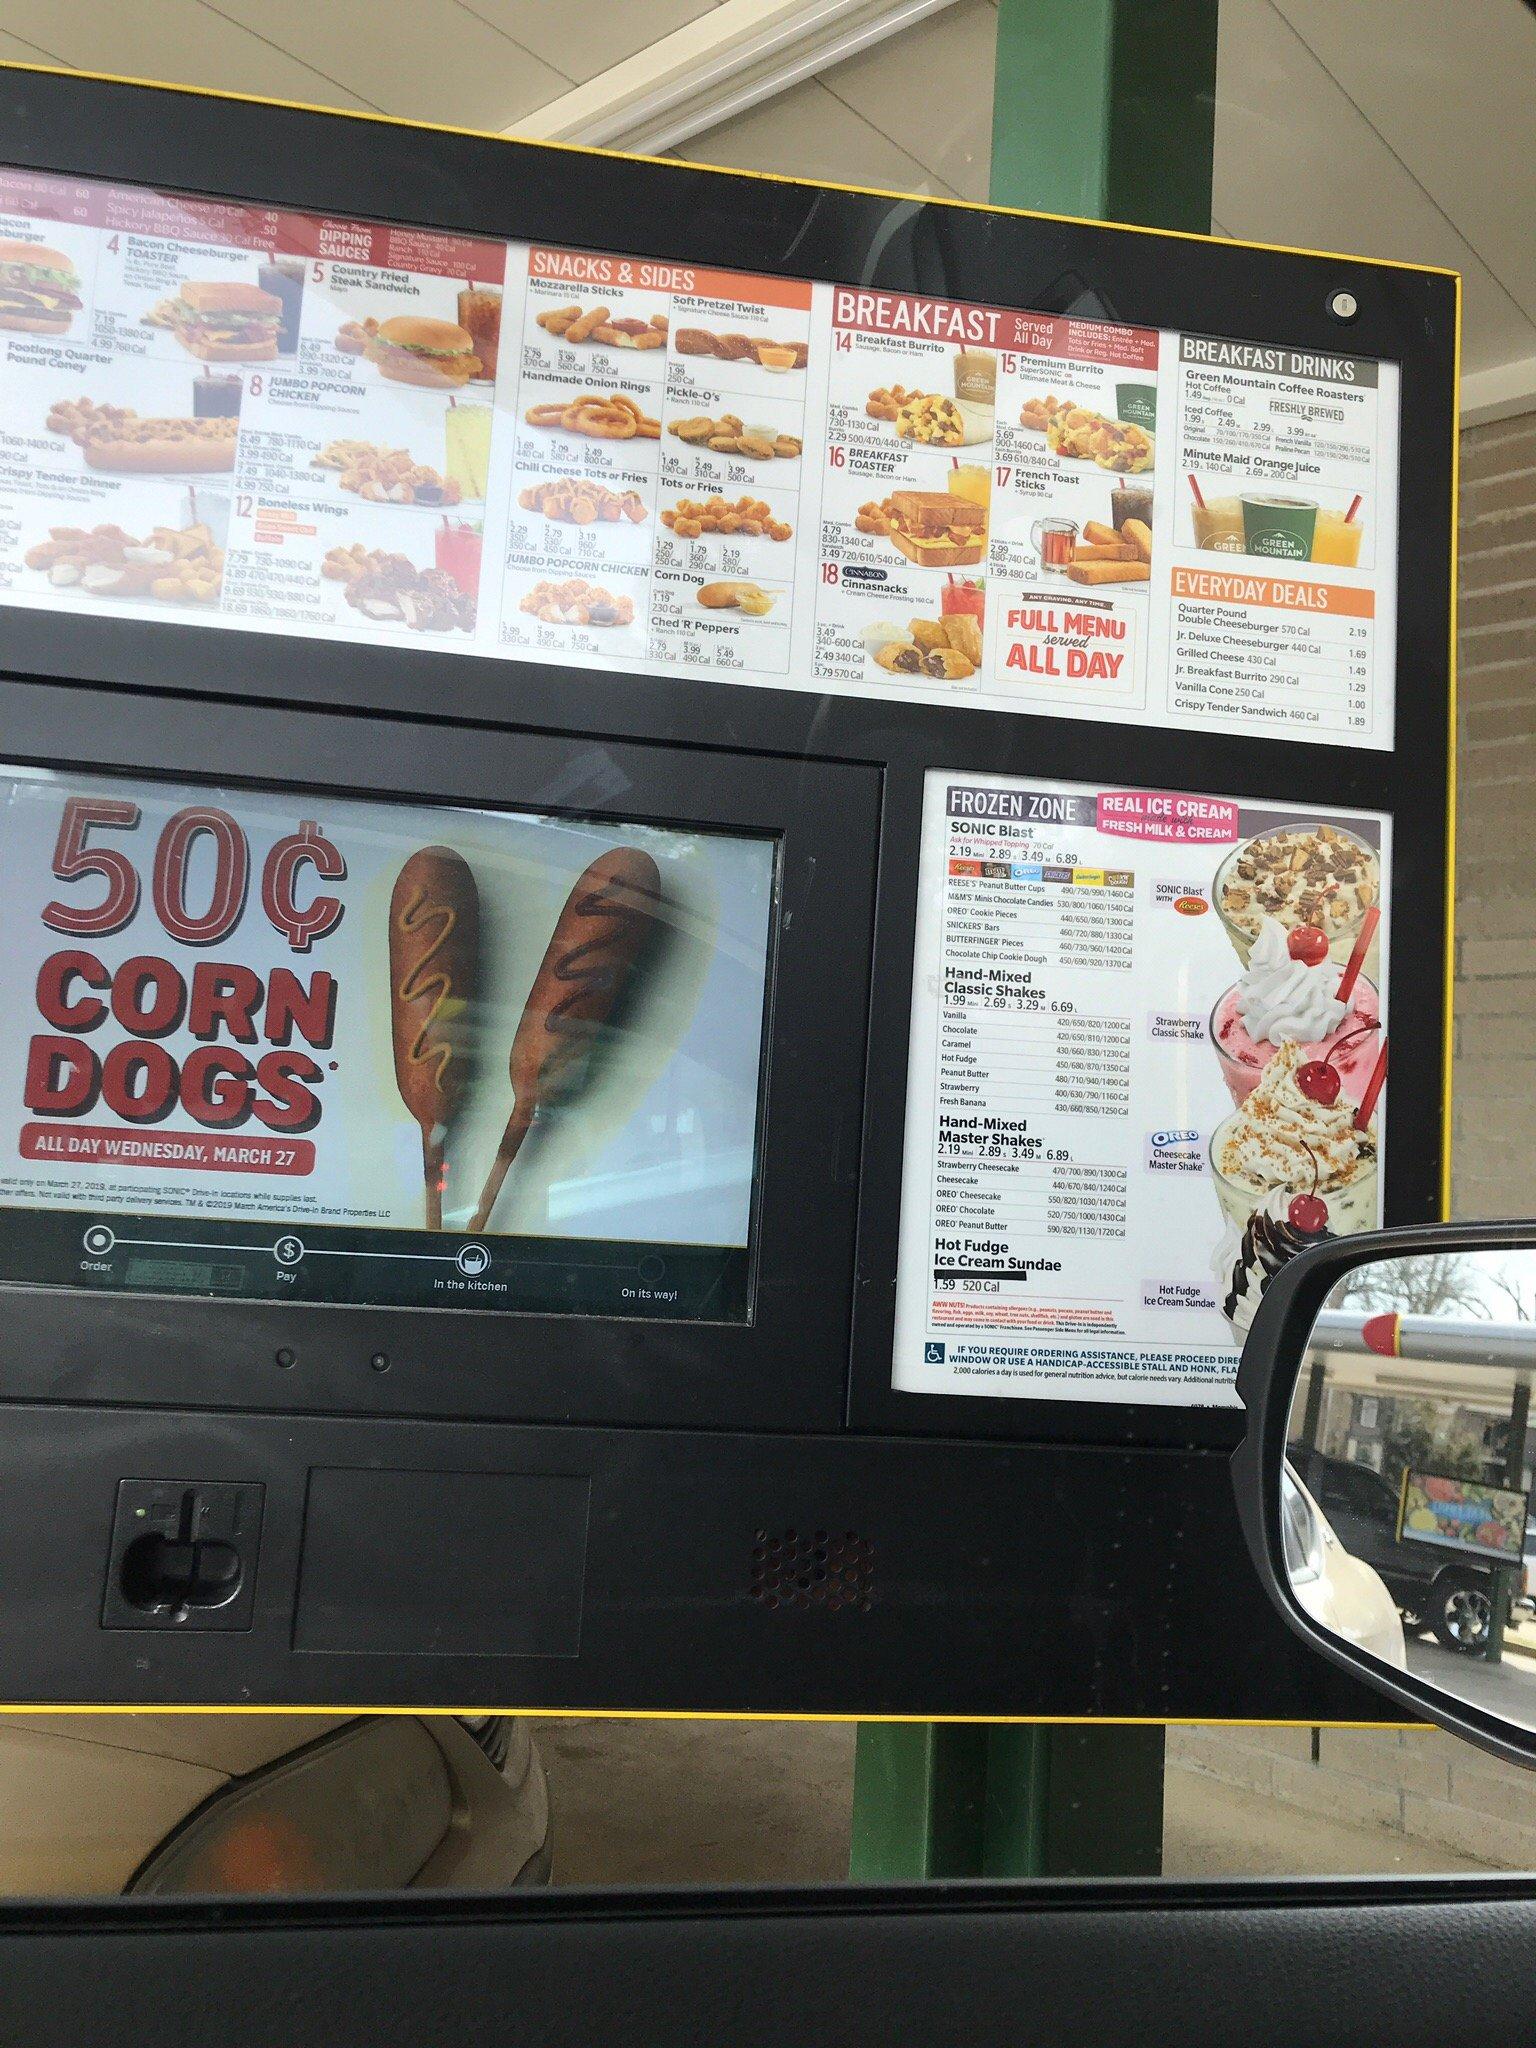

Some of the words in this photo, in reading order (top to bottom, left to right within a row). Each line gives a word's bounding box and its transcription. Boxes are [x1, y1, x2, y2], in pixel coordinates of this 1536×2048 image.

[320, 229, 372, 247] DIPPING
[107, 235, 120, 255] 4
[128, 236, 164, 250] Bacon
[167, 242, 248, 261] Cheeseburger
[319, 243, 370, 261] SAUCES
[312, 262, 324, 283] 5
[332, 264, 378, 281] Country
[381, 271, 409, 283] Fried
[533, 252, 612, 281] SNACKS
[618, 262, 633, 283] &
[640, 266, 694, 290] SIDES
[331, 275, 363, 288] Steak
[366, 280, 420, 295] Sandwich
[530, 278, 589, 295] Mozzarella
[591, 285, 624, 298] Sticks
[673, 296, 695, 307] Soft
[698, 298, 734, 311] Pretzel
[737, 303, 765, 315] Twist
[837, 292, 1000, 343] BREAKFAST
[1015, 318, 1053, 334] Served
[835, 331, 851, 352] 14
[856, 333, 907, 348] Breakfast
[909, 341, 944, 353] Burrito
[1014, 331, 1026, 344] All
[1028, 333, 1052, 349] Day
[1001, 353, 1016, 374] 15
[1020, 356, 1066, 371] Premium
[1068, 361, 1104, 374] Burrito
[1184, 339, 1285, 371] BREAKFAST
[1291, 353, 1355, 382] DRINKS
[251, 375, 263, 396] 8
[269, 376, 309, 389] JUMBO
[311, 382, 366, 396] POPCORN
[522, 371, 582, 386] Handmade
[586, 377, 617, 389] Onion
[620, 380, 650, 394] Rings
[1186, 370, 1220, 383] Green
[1222, 374, 1276, 390] Mountain
[1279, 382, 1314, 395] Coffee
[1317, 387, 1364, 403] Roasters
[269, 389, 320, 401] CHICKEN
[1270, 400, 1306, 415] FRESHLY
[1309, 406, 1344, 421] BREWED
[829, 446, 845, 467] 16
[849, 449, 908, 464] BREAKFAST
[1183, 448, 1221, 462] Minute
[1223, 453, 1249, 465] Maid
[1254, 457, 1293, 471] Orange
[1295, 462, 1321, 474] Juice
[849, 460, 894, 472] TOASTER
[660, 478, 682, 489] Tots
[684, 482, 695, 490] or
[697, 482, 723, 493] Fries
[996, 467, 1011, 487] 17
[1016, 469, 1050, 483] French
[1053, 474, 1079, 486] Toast
[1015, 479, 1046, 491] Sticks
[236, 495, 253, 517] 12
[258, 497, 310, 511] Boneless
[313, 503, 349, 516] Wings
[654, 570, 681, 582] Corn
[683, 574, 705, 586] Dog
[821, 563, 838, 584] 18
[841, 579, 908, 595] Cinnasnacks
[1176, 572, 1267, 601] EVERYDAY
[1273, 583, 1327, 608] DEALS
[1178, 603, 1214, 616] Quarter
[1217, 607, 1247, 619] Pound
[1007, 609, 1059, 634] FULL
[1064, 613, 1125, 640] MENU
[1178, 614, 1212, 625] Double
[1213, 618, 1279, 633] Cheeseburger
[1349, 628, 1367, 637] 2.19
[1043, 635, 1090, 649] served
[1177, 631, 1186, 640] Jr.
[1189, 632, 1221, 643] Deluxe
[1223, 635, 1289, 651] Cheeseburger
[1007, 643, 1059, 674] ALL
[1067, 649, 1123, 679] DAY
[1177, 648, 1208, 659] Grilled
[1211, 652, 1244, 662] Cheese
[1349, 650, 1366, 658] 1.69
[1349, 667, 1366, 675] 1.49
[1176, 681, 1207, 693] Vanilla
[1209, 685, 1234, 695] Cone
[1175, 699, 1205, 712] Crispy
[1207, 702, 1239, 714] Tender
[1242, 705, 1287, 718] Sandwich
[1348, 700, 1365, 709] 1.00
[1348, 717, 1365, 726] 1.89
[951, 791, 1023, 816] FROZEN
[1029, 797, 1077, 820] ZONE
[1103, 797, 1143, 815] REAL
[1147, 799, 1172, 814] ICE
[1176, 800, 1232, 820] CREAM
[951, 821, 996, 836] SONIC
[1102, 820, 1142, 833] FRESH
[1144, 823, 1173, 836] MILK
[1176, 826, 1186, 837] &
[1189, 826, 1231, 839] CREAM
[949, 846, 971, 857] 2.19
[989, 848, 1011, 860] 2.89
[1022, 850, 1044, 862] 3.49
[1056, 853, 1078, 865] 6.89
[945, 967, 1032, 984] Hand-Mixed
[36, 950, 338, 1049] CORN
[944, 982, 993, 996] Classic
[996, 985, 1046, 1000] Shakes
[944, 995, 966, 1006] 1.99
[984, 997, 1006, 1008] 2.69
[1016, 999, 1039, 1010] 3.29
[1051, 1002, 1073, 1013] 6.69
[943, 1011, 966, 1021] Vanilla
[1156, 1017, 1201, 1030] Strawberry
[942, 1025, 978, 1036] Chocolate
[1152, 1028, 1179, 1038] Classic
[1181, 1030, 1204, 1040] Shake
[942, 1040, 971, 1049] Caramel
[939, 1115, 1027, 1132] Hand-Mixed
[939, 1131, 989, 1146] Master
[992, 1134, 1042, 1148] Shakes
[35, 1135, 64, 1152] ALL
[68, 1137, 101, 1155] DAY
[105, 1140, 208, 1162] WEDNESDAY,
[215, 1149, 270, 1165] MARCH
[276, 1151, 295, 1167] 27
[935, 1238, 961, 1251] Hot
[964, 1239, 1009, 1255] Fudge
[80, 1261, 112, 1272] Order
[934, 1255, 955, 1267] Ice
[958, 1255, 1005, 1269] Cream
[1008, 1257, 1061, 1272] Sundae
[277, 1272, 297, 1284] Pay
[434, 1279, 444, 1289] In
[447, 1280, 465, 1289] the
[468, 1281, 507, 1291] kitchen
[933, 1279, 955, 1291] 1.59
[622, 1288, 635, 1298] On
[638, 1289, 650, 1298] its
[654, 1290, 678, 1301] way!
[968, 1346, 986, 1354] YOU
[989, 1348, 1028, 1356] REQUIRE
[1031, 1349, 1078, 1358] ORDERING
[1081, 1350, 1138, 1362] ASSISTANCE,
[1140, 1354, 1172, 1362] PLEASE
[1175, 1355, 1216, 1363] PROCEED
